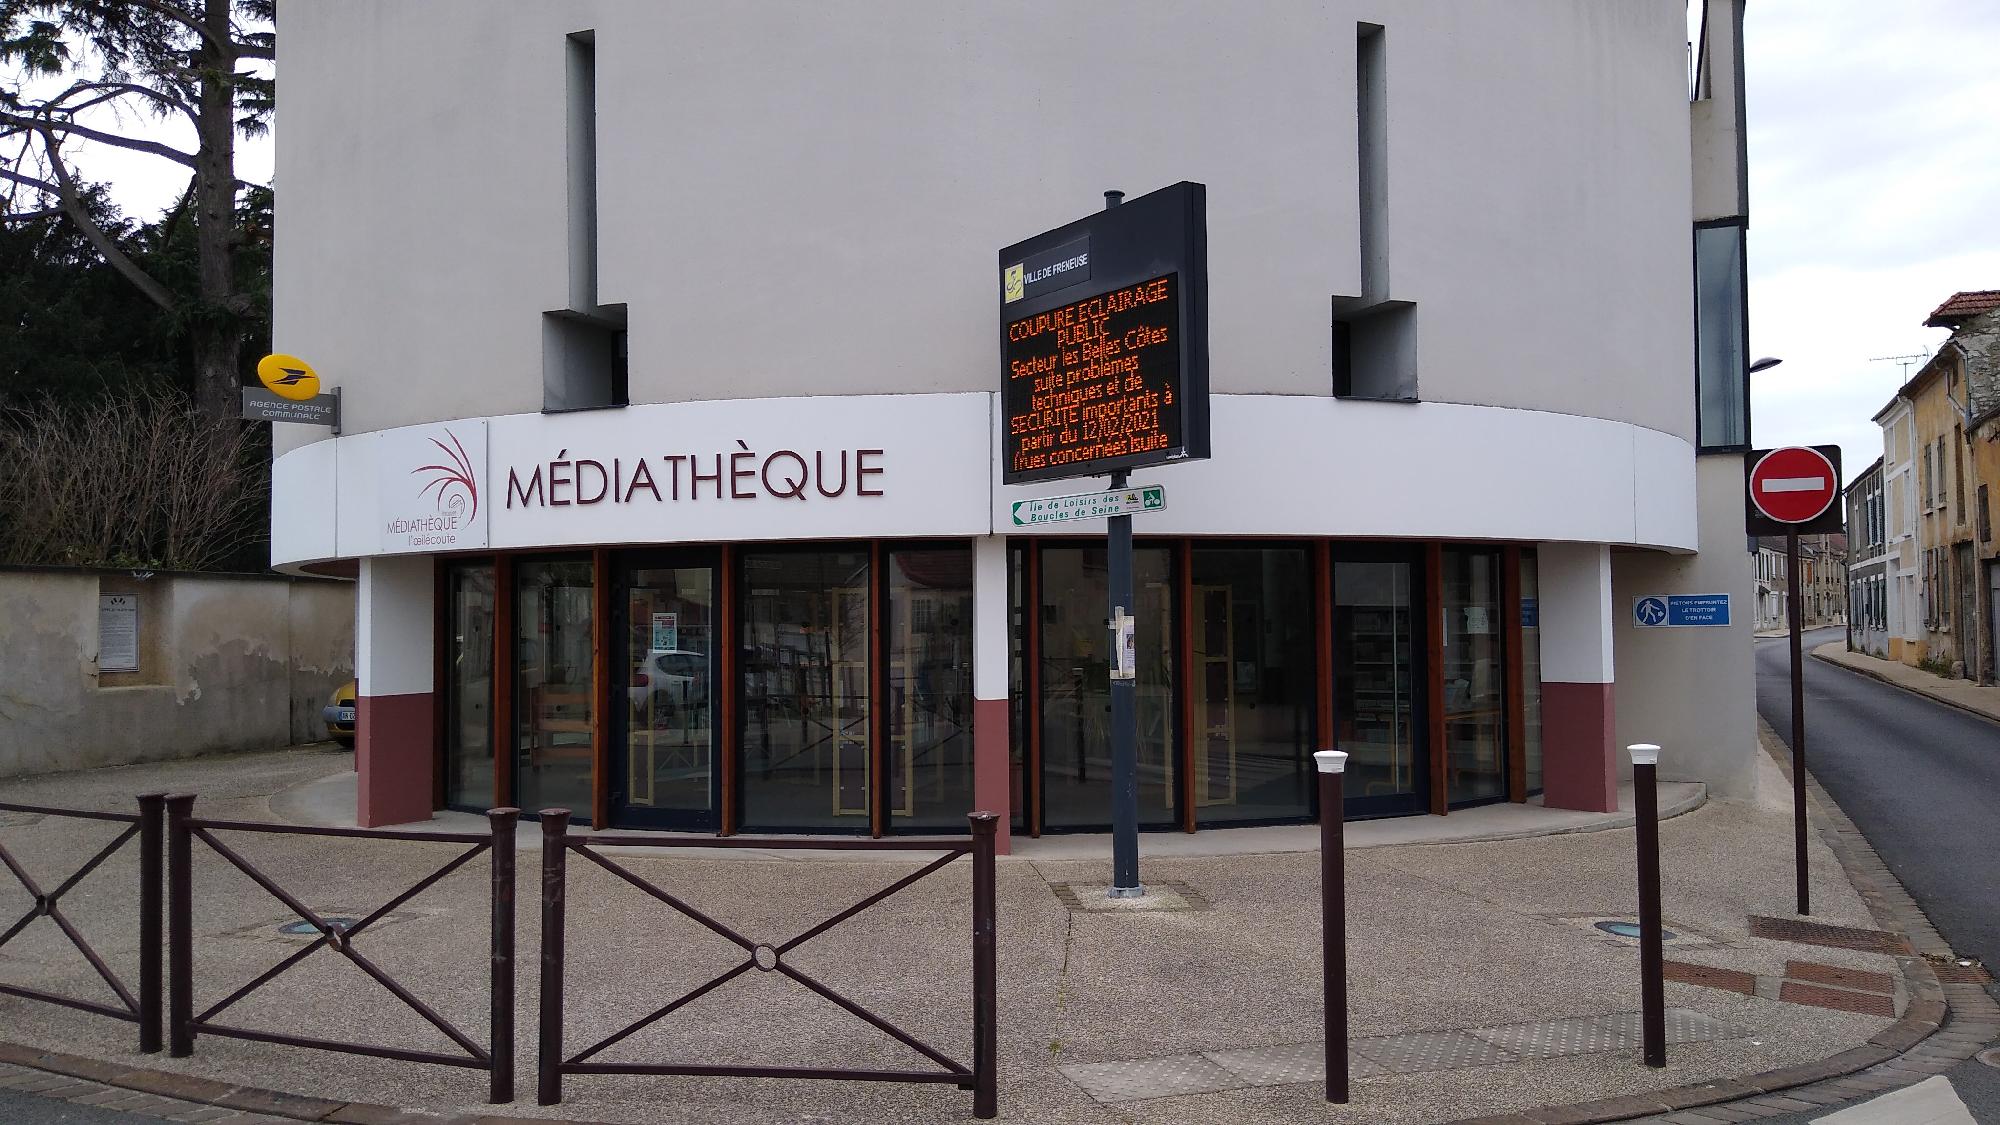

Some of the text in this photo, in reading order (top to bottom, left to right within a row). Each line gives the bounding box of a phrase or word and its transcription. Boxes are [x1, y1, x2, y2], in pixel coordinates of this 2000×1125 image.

[1024, 253, 1088, 284] VILLE DE FRENEUSE
[1009, 279, 1169, 342] COUPURE ECLAIRAGE
[1057, 317, 1110, 349] PUBLIC
[1011, 325, 1168, 379] Secteur les Belles Côtes
[1031, 370, 1143, 412] techniques et de
[1034, 373, 1063, 393] suite
[249, 400, 332, 414] AGENCE POSTALE
[262, 409, 320, 420] COMMUNALE
[1011, 381, 1174, 435] SECURITE importants à
[1021, 430, 1056, 456] partir
[1060, 426, 1078, 444] du
[506, 439, 884, 509] MÉDIATHÈQUE
[1030, 504, 1120, 522] Boucles de Seine
[1047, 500, 1059, 510] de
[1064, 497, 1097, 508] Loisirs
[1102, 494, 1119, 503] des
[387, 514, 458, 534] MÉDIATHÈQUE
